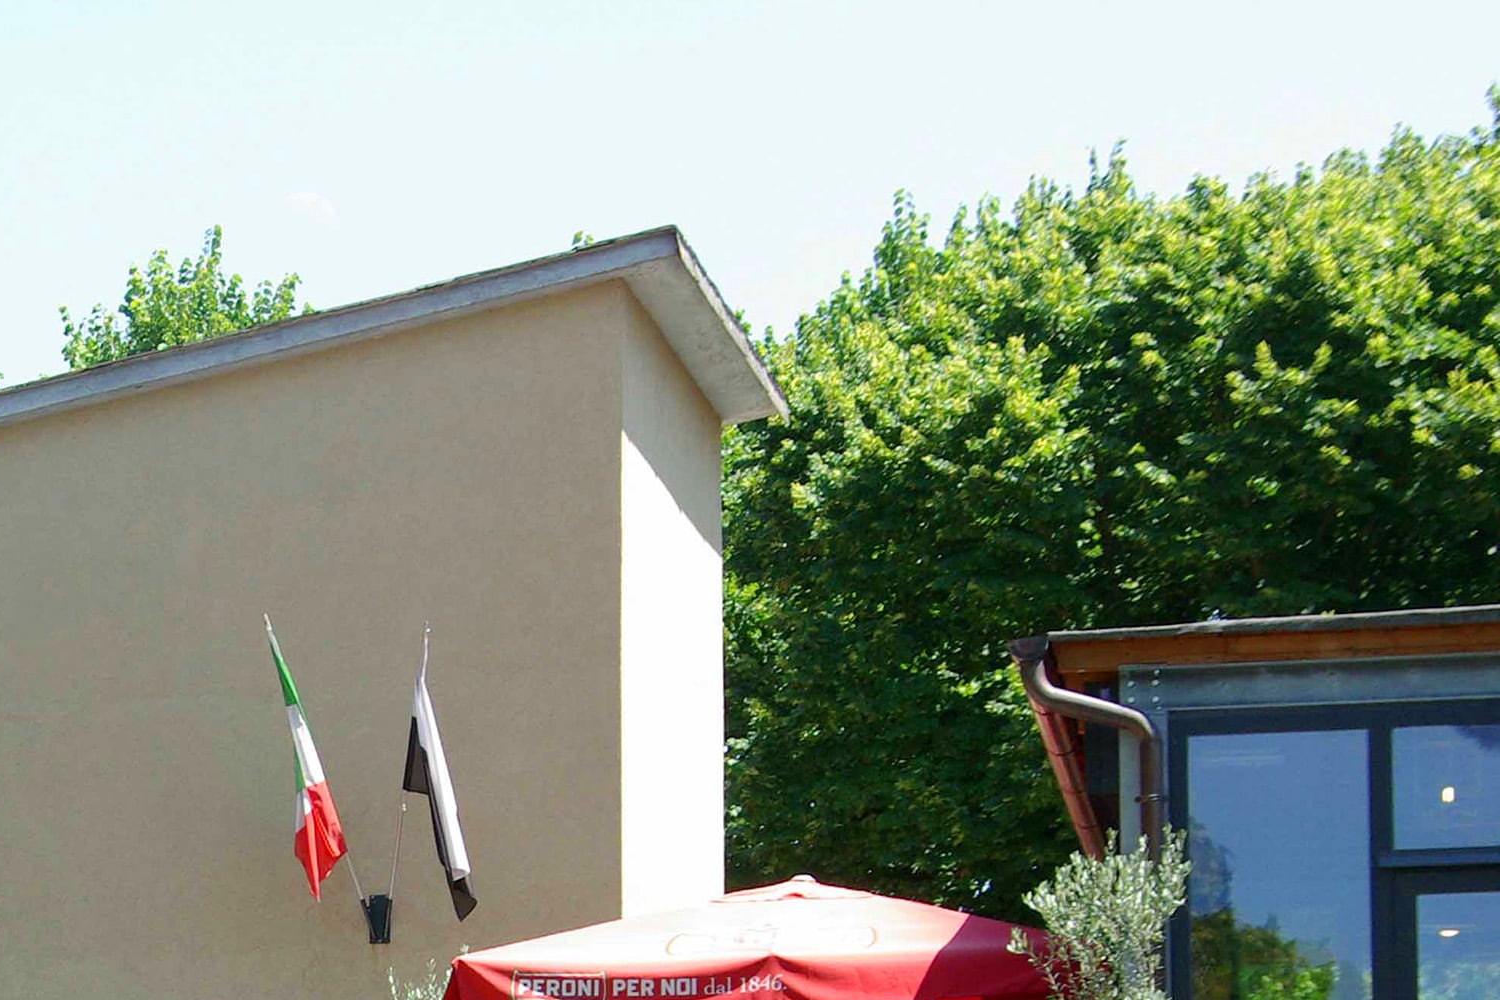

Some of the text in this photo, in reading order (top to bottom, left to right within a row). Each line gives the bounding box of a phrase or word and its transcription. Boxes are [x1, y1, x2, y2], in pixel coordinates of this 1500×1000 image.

[518, 978, 600, 997] PERONI
[612, 978, 655, 997] PER
[660, 978, 698, 996] NOI
[703, 976, 733, 995] dal
